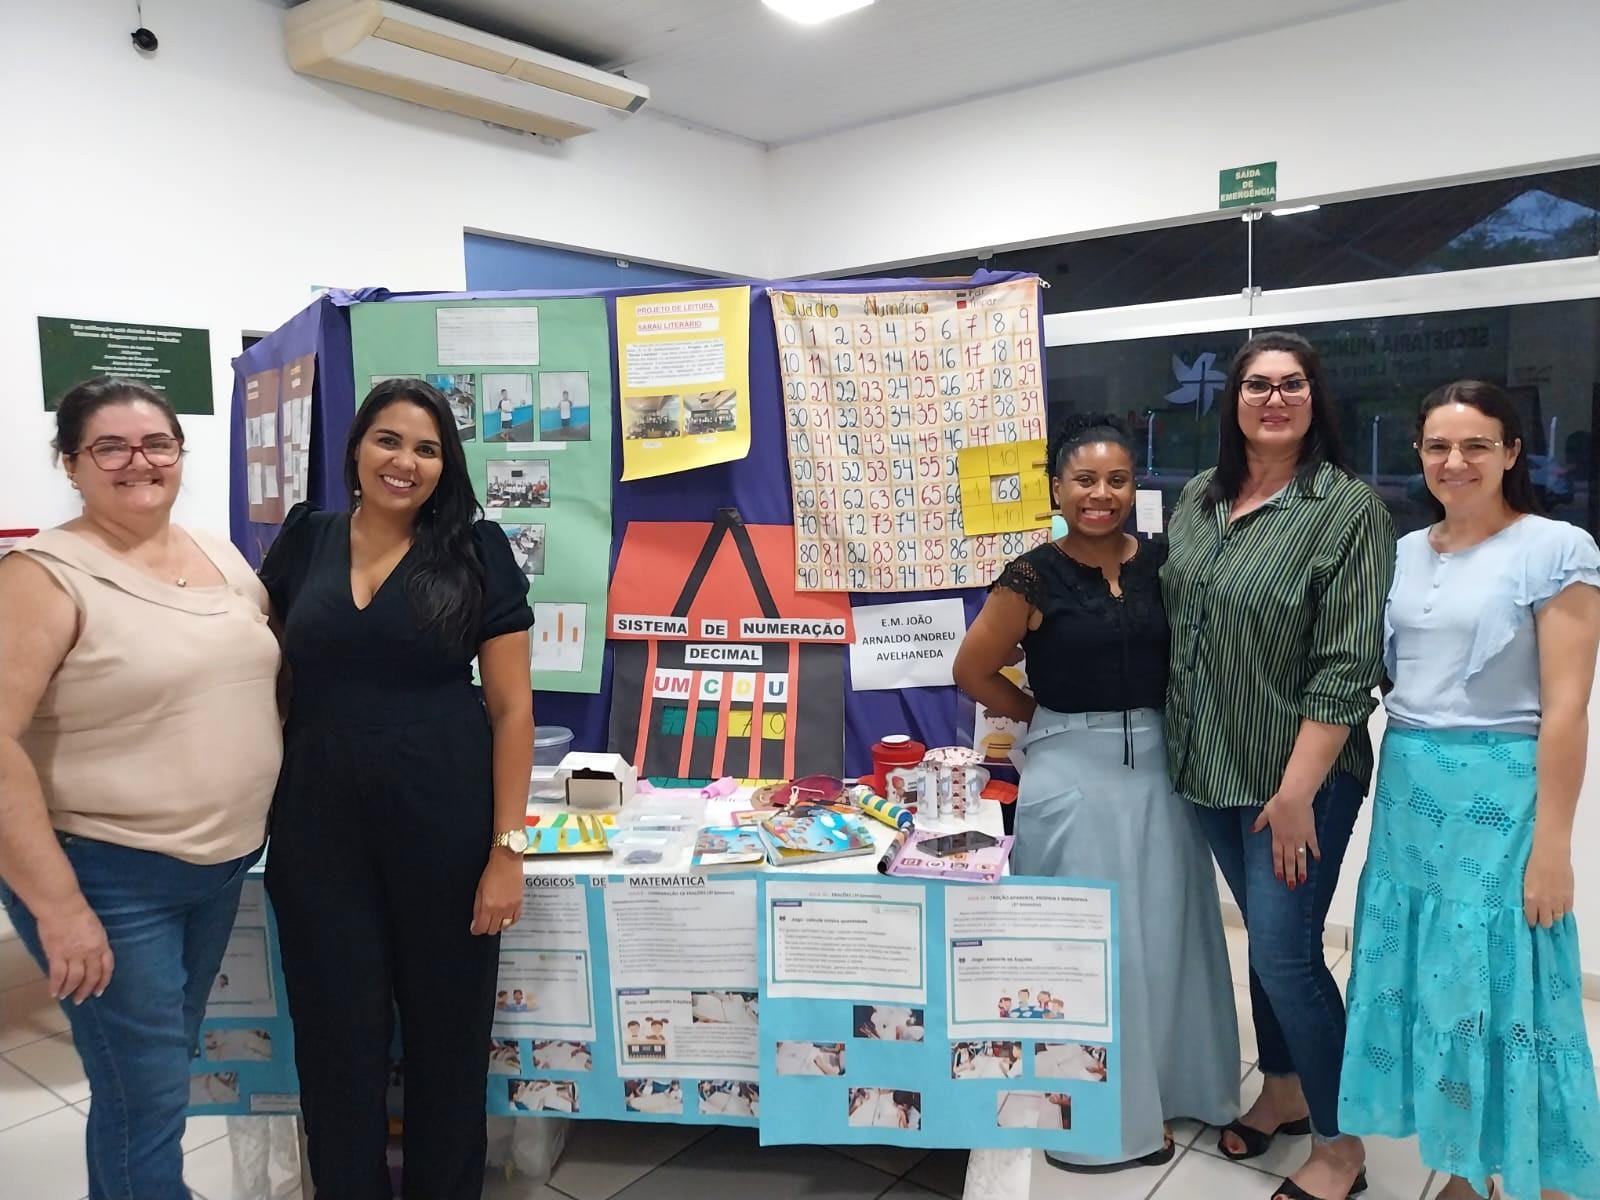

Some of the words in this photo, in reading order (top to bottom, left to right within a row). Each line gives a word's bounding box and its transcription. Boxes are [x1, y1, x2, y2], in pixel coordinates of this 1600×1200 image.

[1235, 168, 1260, 180] SAÍDA
[1220, 186, 1276, 202] EMERGÊNCIA
[1242, 180, 1254, 189] DE
[637, 305, 670, 315] PROJETO
[672, 304, 681, 312] DE
[782, 294, 838, 318] Quadro
[864, 296, 928, 316] Numérico
[638, 322, 662, 332] SARAU
[664, 320, 702, 329] LITERÁRIO
[784, 324, 796, 344] 0
[809, 325, 816, 346] 1
[834, 326, 849, 345] 2
[859, 324, 872, 345] 3
[886, 322, 897, 344] 4
[914, 321, 926, 342] 5
[942, 319, 951, 340] 6
[966, 314, 978, 338] 7
[993, 312, 1005, 334] 8
[1019, 307, 1029, 334] 9
[783, 352, 799, 373] 10
[808, 352, 822, 374] 11
[834, 352, 854, 373] 12
[858, 352, 877, 374] 13
[885, 350, 903, 372] 14
[911, 349, 929, 372] 15
[939, 348, 956, 369] 16
[964, 342, 981, 368] 17
[992, 339, 1008, 362] 18
[1017, 337, 1032, 360] 19
[787, 381, 807, 401] 20
[810, 381, 829, 402] 21
[836, 380, 857, 402] 22
[861, 380, 884, 402] 23
[888, 377, 909, 400] 24
[914, 376, 936, 399] 25
[940, 375, 960, 396] 26
[966, 368, 984, 392] 27
[992, 368, 1013, 389] 28
[1018, 363, 1036, 386] 29
[789, 408, 808, 427] 30
[813, 408, 831, 430] 31
[838, 407, 860, 428] 32
[863, 406, 885, 429] 33
[890, 404, 911, 428] 34
[916, 403, 938, 425] 35
[943, 401, 963, 422] 36
[969, 395, 988, 419] 37
[995, 394, 1016, 417] 38
[1021, 390, 1039, 412] 39
[790, 432, 809, 453] 40
[815, 434, 832, 456] 41
[838, 434, 861, 456] 42
[864, 433, 884, 455] 43
[891, 433, 911, 455] 44
[919, 432, 938, 453] 45
[944, 428, 963, 451] 46
[970, 425, 989, 446] 47
[997, 421, 1017, 442] 48
[1022, 418, 1041, 440] 49
[794, 460, 812, 480] 50
[816, 461, 834, 482] 51
[841, 461, 863, 482] 52
[867, 460, 888, 482] 53
[893, 459, 914, 481] 54
[919, 456, 940, 477] 55
[797, 489, 815, 508] 60
[820, 488, 836, 510] 61
[843, 489, 864, 509] 62
[869, 489, 890, 509] 63
[895, 487, 915, 507] 64
[922, 485, 941, 505] 65
[998, 478, 1020, 500] 68
[798, 514, 817, 535] 70
[820, 513, 837, 536] 71
[846, 514, 867, 535] 72
[871, 513, 892, 534] 73
[896, 512, 916, 533] 74
[923, 511, 943, 531] 75
[800, 544, 819, 563] 80
[823, 542, 839, 565] 81
[848, 541, 868, 563] 82
[873, 541, 893, 565] 83
[897, 540, 916, 561] 84
[925, 539, 944, 560] 85
[950, 539, 968, 559] 86
[976, 535, 997, 558] 87
[1003, 532, 1024, 555] 88
[798, 568, 818, 588] 90
[825, 568, 839, 589] 91
[849, 568, 867, 589] 92
[874, 566, 894, 589] 93
[898, 565, 916, 588] 94
[924, 564, 944, 586] 95
[950, 563, 967, 585] 96
[977, 560, 996, 583] 97
[618, 619, 688, 634] SISTEMA
[705, 624, 725, 636] DE
[743, 622, 845, 637] NUMERAÇÃO
[881, 618, 904, 627] E.M.
[906, 614, 933, 626] JOÃO
[862, 634, 911, 645] ARNALDO
[914, 632, 955, 642] ANDREU
[690, 648, 760, 660] DECIMAL
[876, 649, 944, 661] AVELHANEDA
[654, 676, 690, 693] UM
[704, 679, 719, 694] C
[736, 680, 750, 693] D
[768, 681, 784, 696] U
[592, 878, 606, 887] DE
[629, 874, 705, 886] MATEMÁTICA
